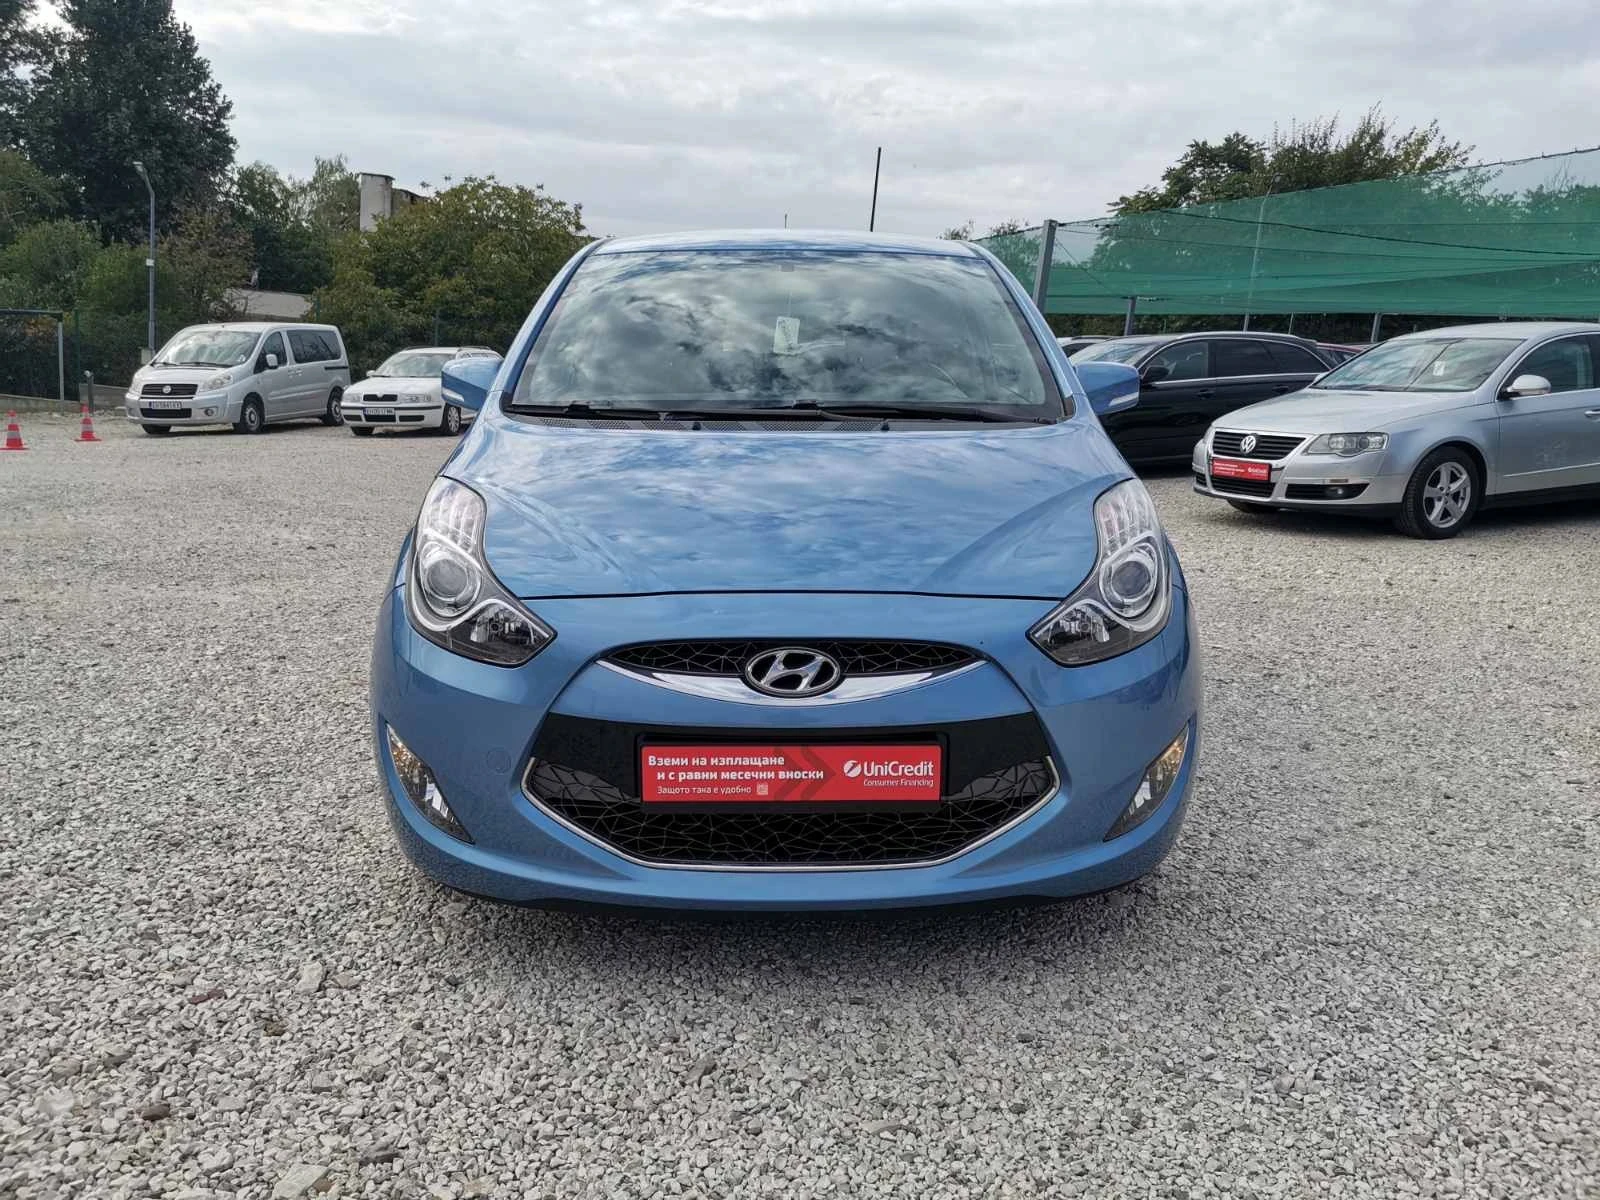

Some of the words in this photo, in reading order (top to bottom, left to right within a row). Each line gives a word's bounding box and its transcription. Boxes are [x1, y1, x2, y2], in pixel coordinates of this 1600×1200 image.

[648, 755, 688, 766] Вземи
[692, 757, 707, 766] на
[711, 756, 785, 767] изплащане
[863, 761, 934, 776] UniCredit
[657, 771, 665, 780] и
[668, 771, 675, 780] с
[678, 771, 718, 782] равни
[721, 770, 775, 780] месечни
[778, 770, 824, 779] вноски
[863, 778, 899, 787] Consumer
[901, 778, 934, 788] Financing
[657, 786, 690, 795] Защото
[720, 785, 752, 795] удобно
